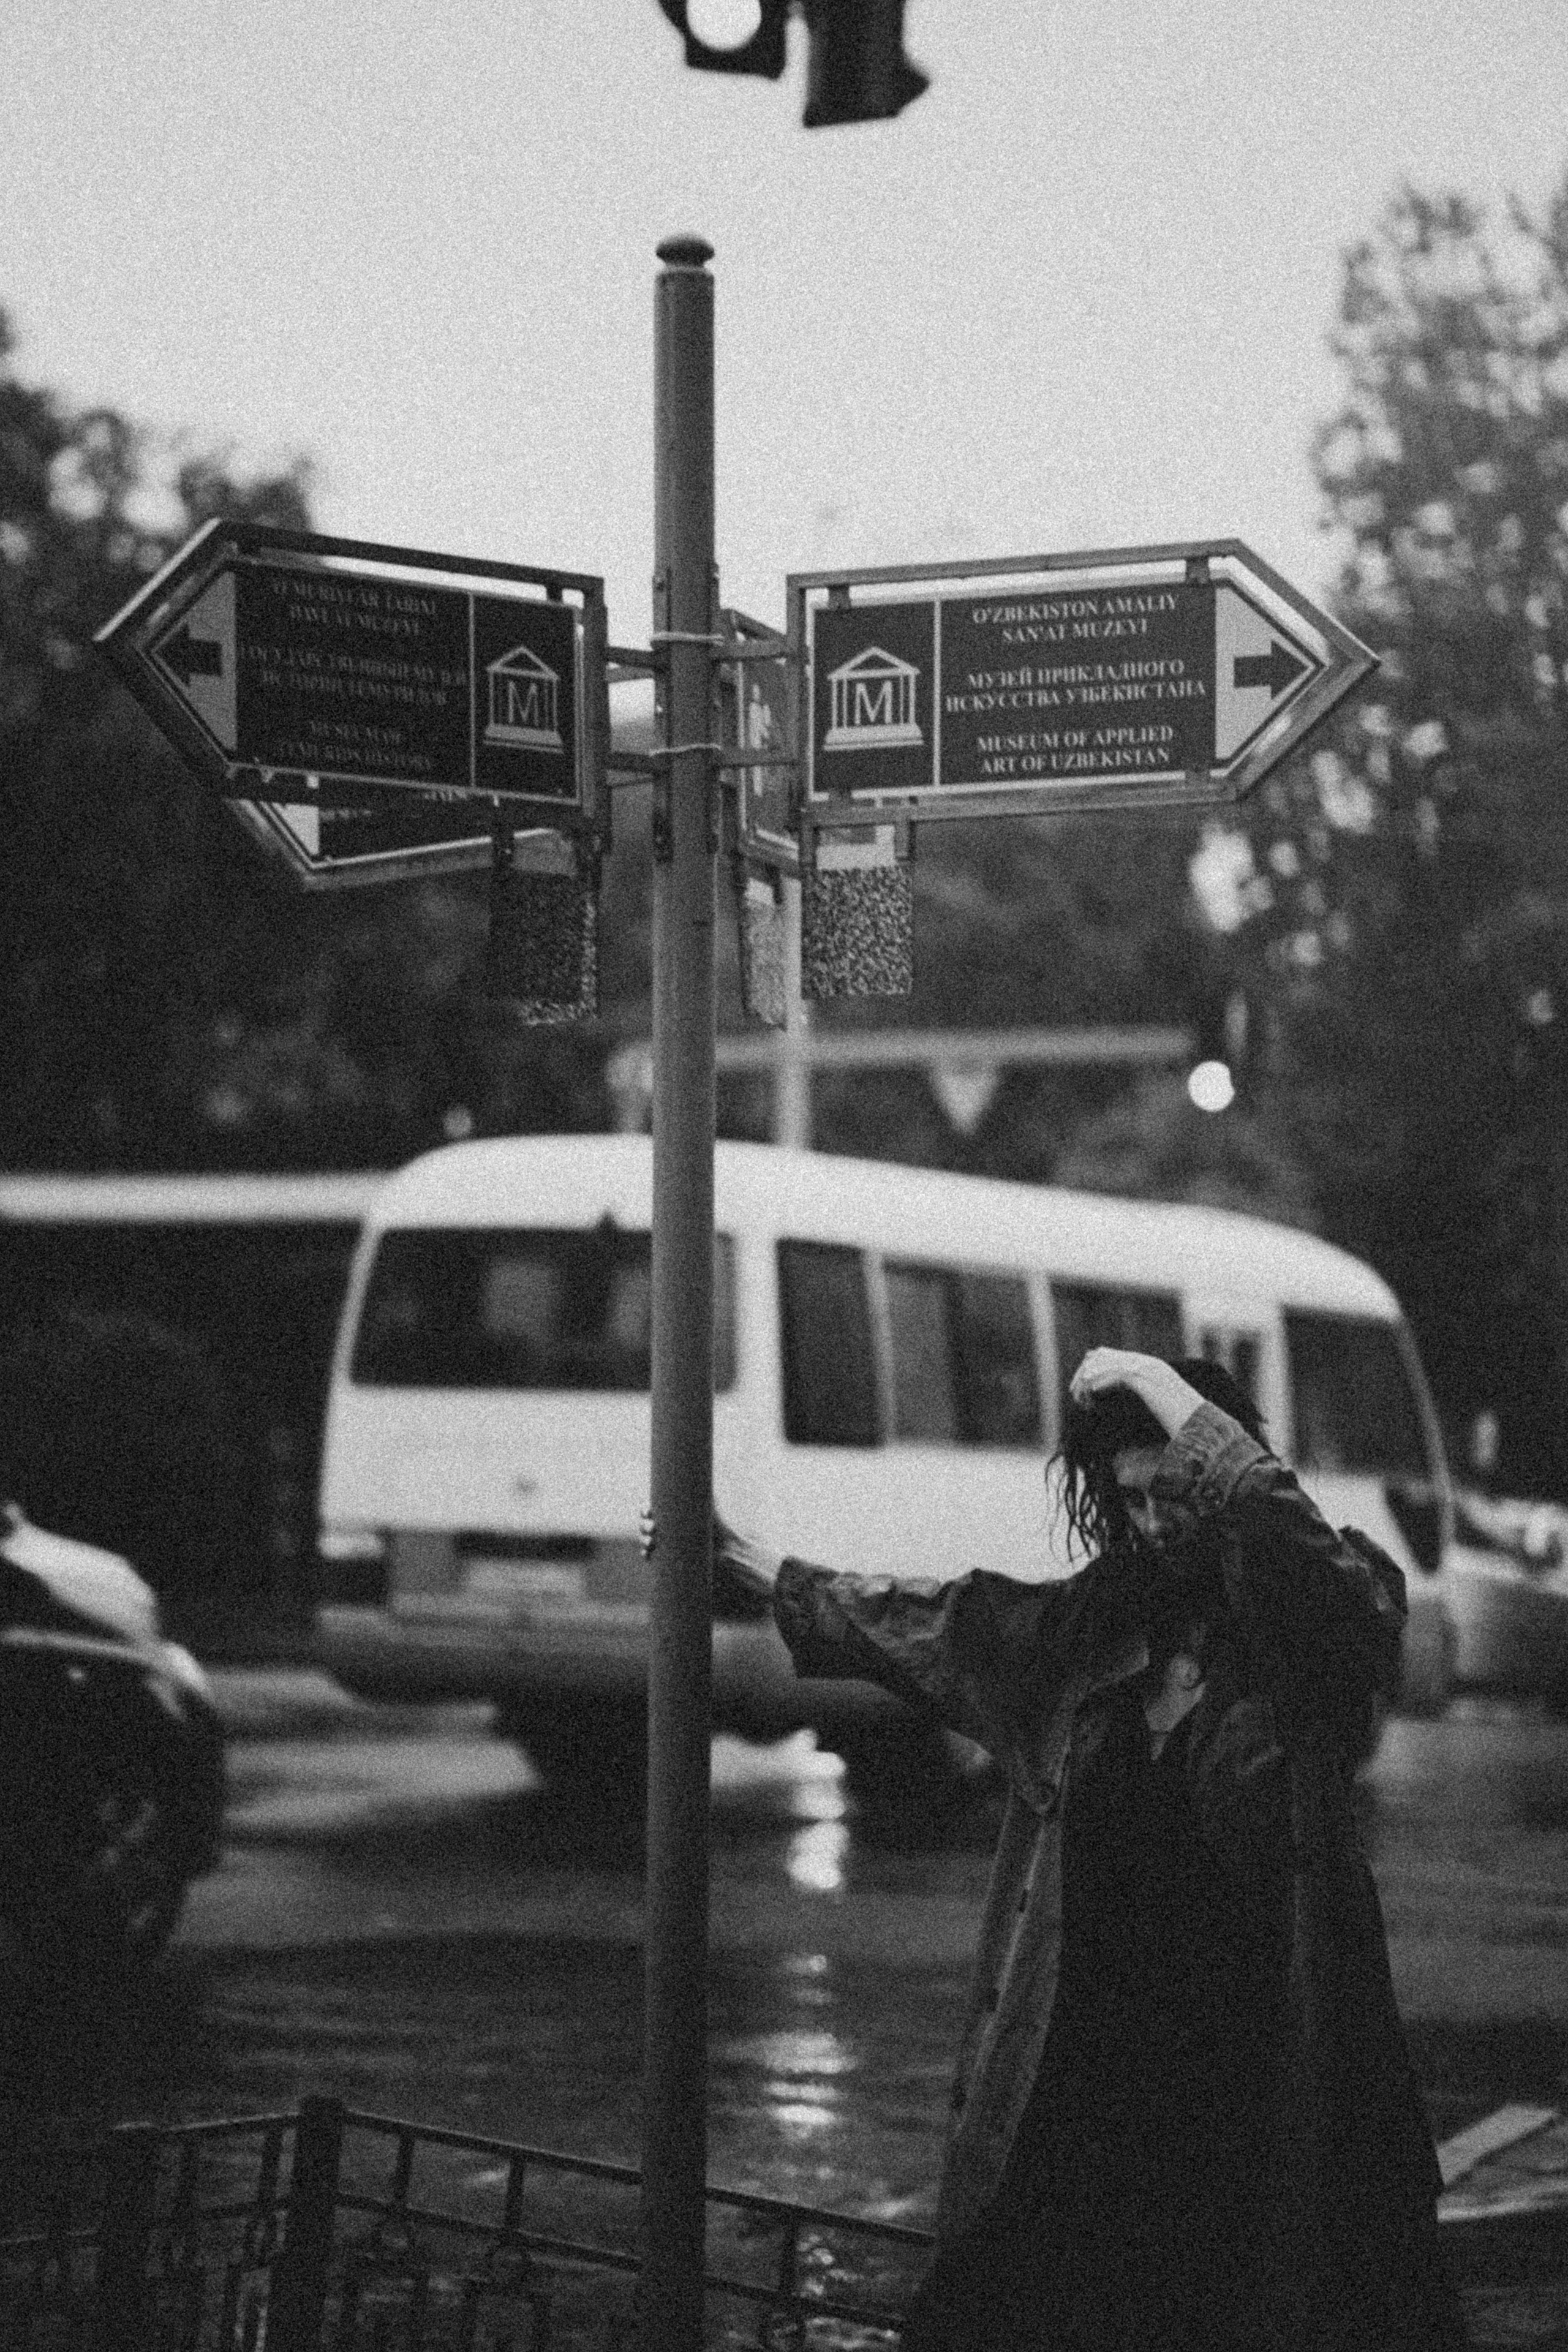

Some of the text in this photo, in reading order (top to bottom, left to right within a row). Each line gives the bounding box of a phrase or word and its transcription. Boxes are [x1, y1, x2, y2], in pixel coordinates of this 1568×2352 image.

[1104, 594, 1179, 614] AMALIY
[1072, 617, 1149, 639] MUZEYI
[968, 658, 1185, 689] МУЗЕЙ ПРИКЛАДНОГО
[946, 690, 1060, 712] ИСКУССТВА
[978, 725, 1174, 753] MUSEUM OF APPLIED
[981, 747, 1170, 774] ART OF UZBEKISTAN
